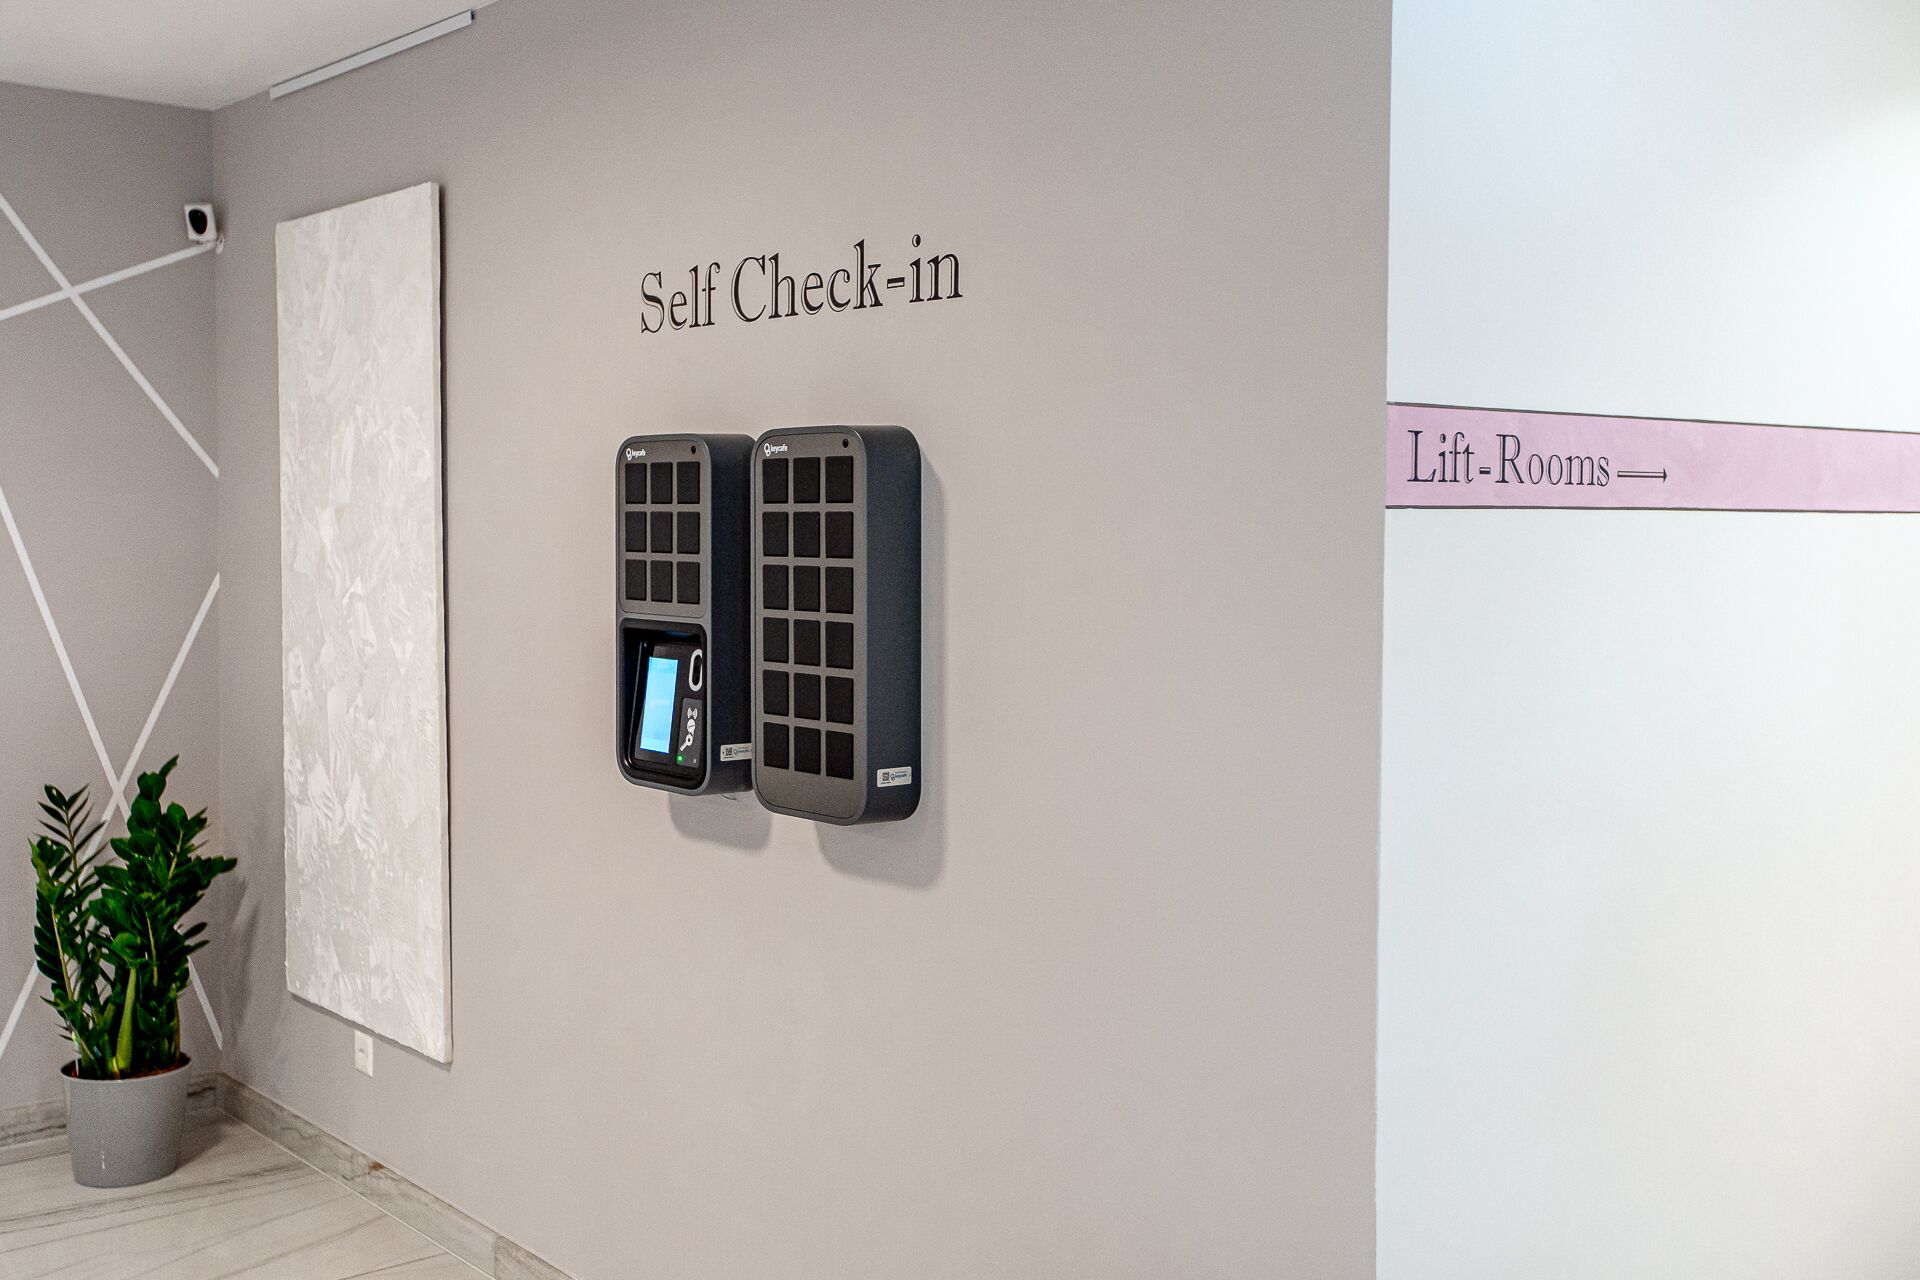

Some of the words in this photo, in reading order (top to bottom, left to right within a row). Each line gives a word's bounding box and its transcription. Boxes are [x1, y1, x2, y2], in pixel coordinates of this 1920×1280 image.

[641, 262, 720, 334] Self
[731, 234, 963, 322] Check-in
[1406, 429, 1610, 487] Lift-Rooms
